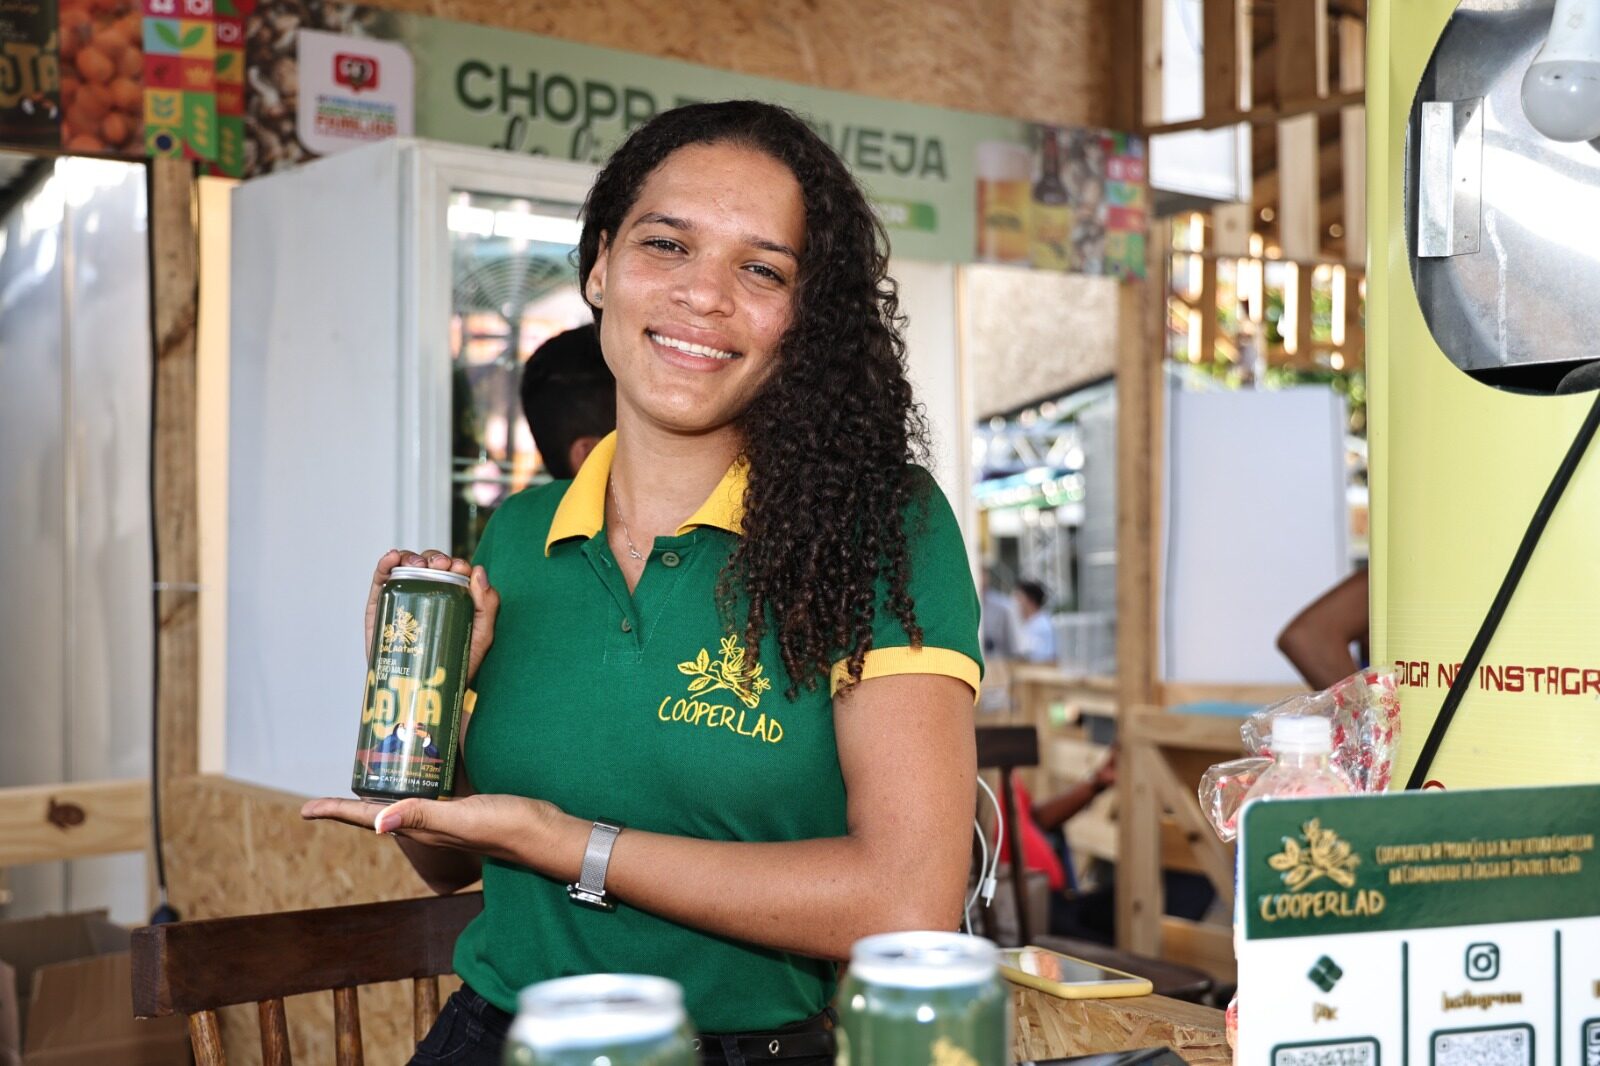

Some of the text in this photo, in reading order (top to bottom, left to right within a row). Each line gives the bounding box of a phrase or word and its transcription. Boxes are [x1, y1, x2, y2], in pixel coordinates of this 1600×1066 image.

[1480, 665, 1600, 695] INSTAGR
[658, 695, 784, 744] COOPERLAD
[422, 780, 439, 788] SOUR
[1260, 888, 1386, 922] COOPERLAD
